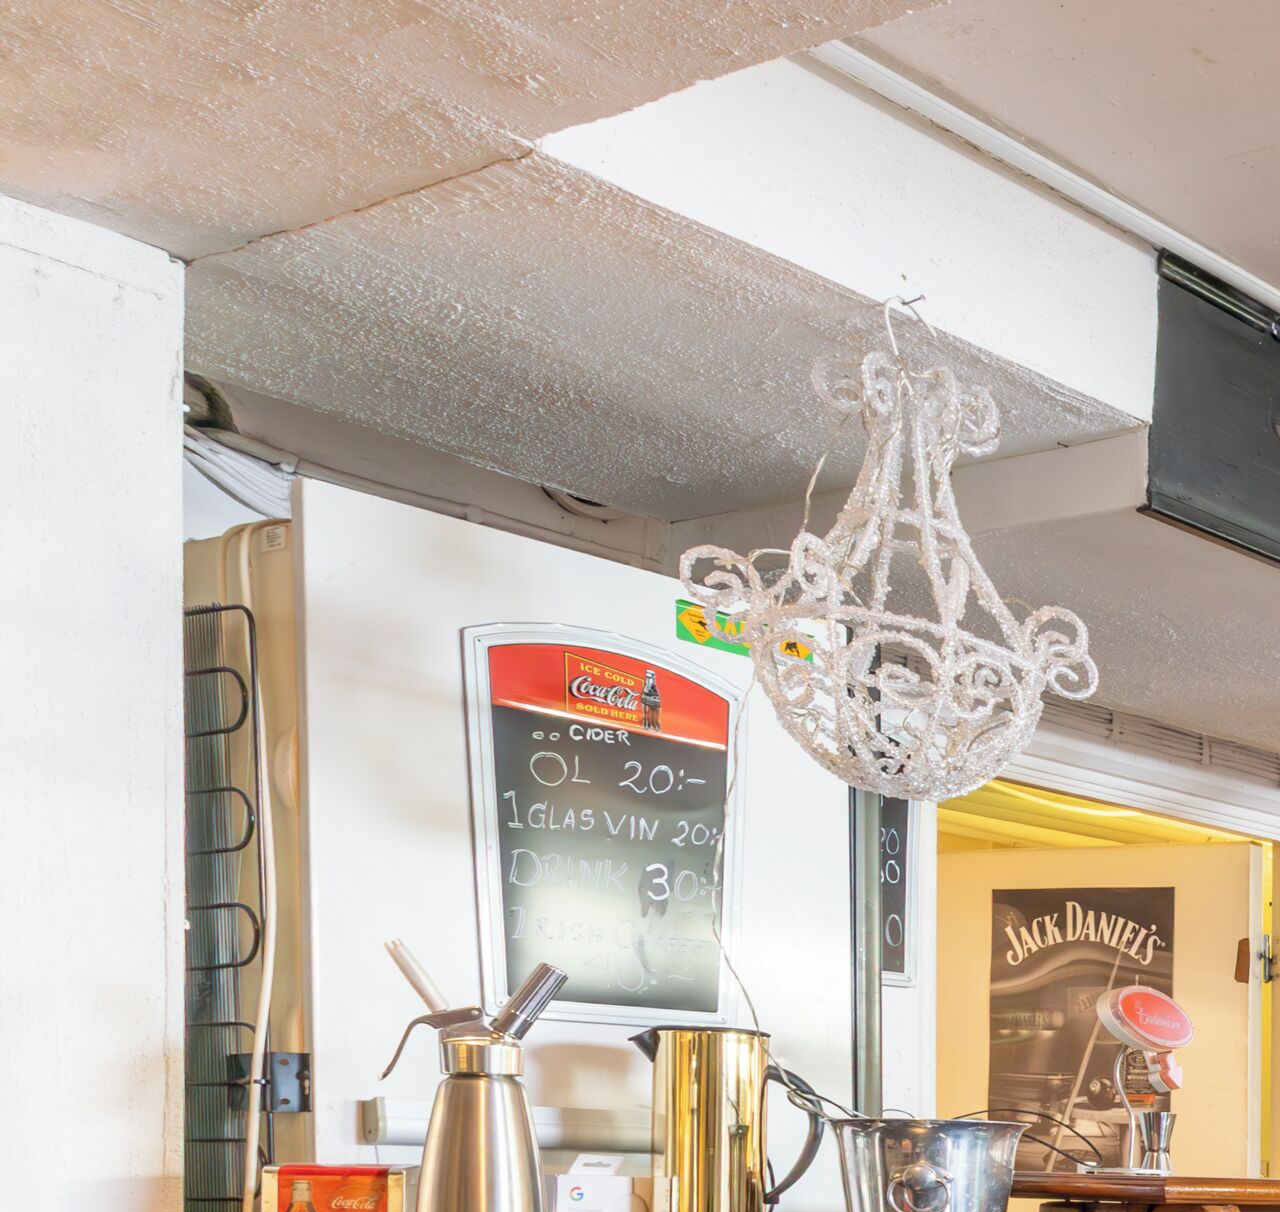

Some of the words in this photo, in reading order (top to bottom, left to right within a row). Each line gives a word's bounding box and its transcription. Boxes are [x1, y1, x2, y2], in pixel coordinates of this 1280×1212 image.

[579, 662, 601, 677] ICE
[604, 671, 635, 687] COLD
[570, 675, 640, 711] Coca-Cola
[576, 702, 608, 716] SOLD
[610, 710, 639, 722] HERE
[569, 724, 631, 746] CIDER
[528, 801, 595, 831] GLAS
[603, 811, 659, 841] VIN
[1004, 913, 1064, 966] JACK
[1065, 901, 1162, 966] DANIEL'S
